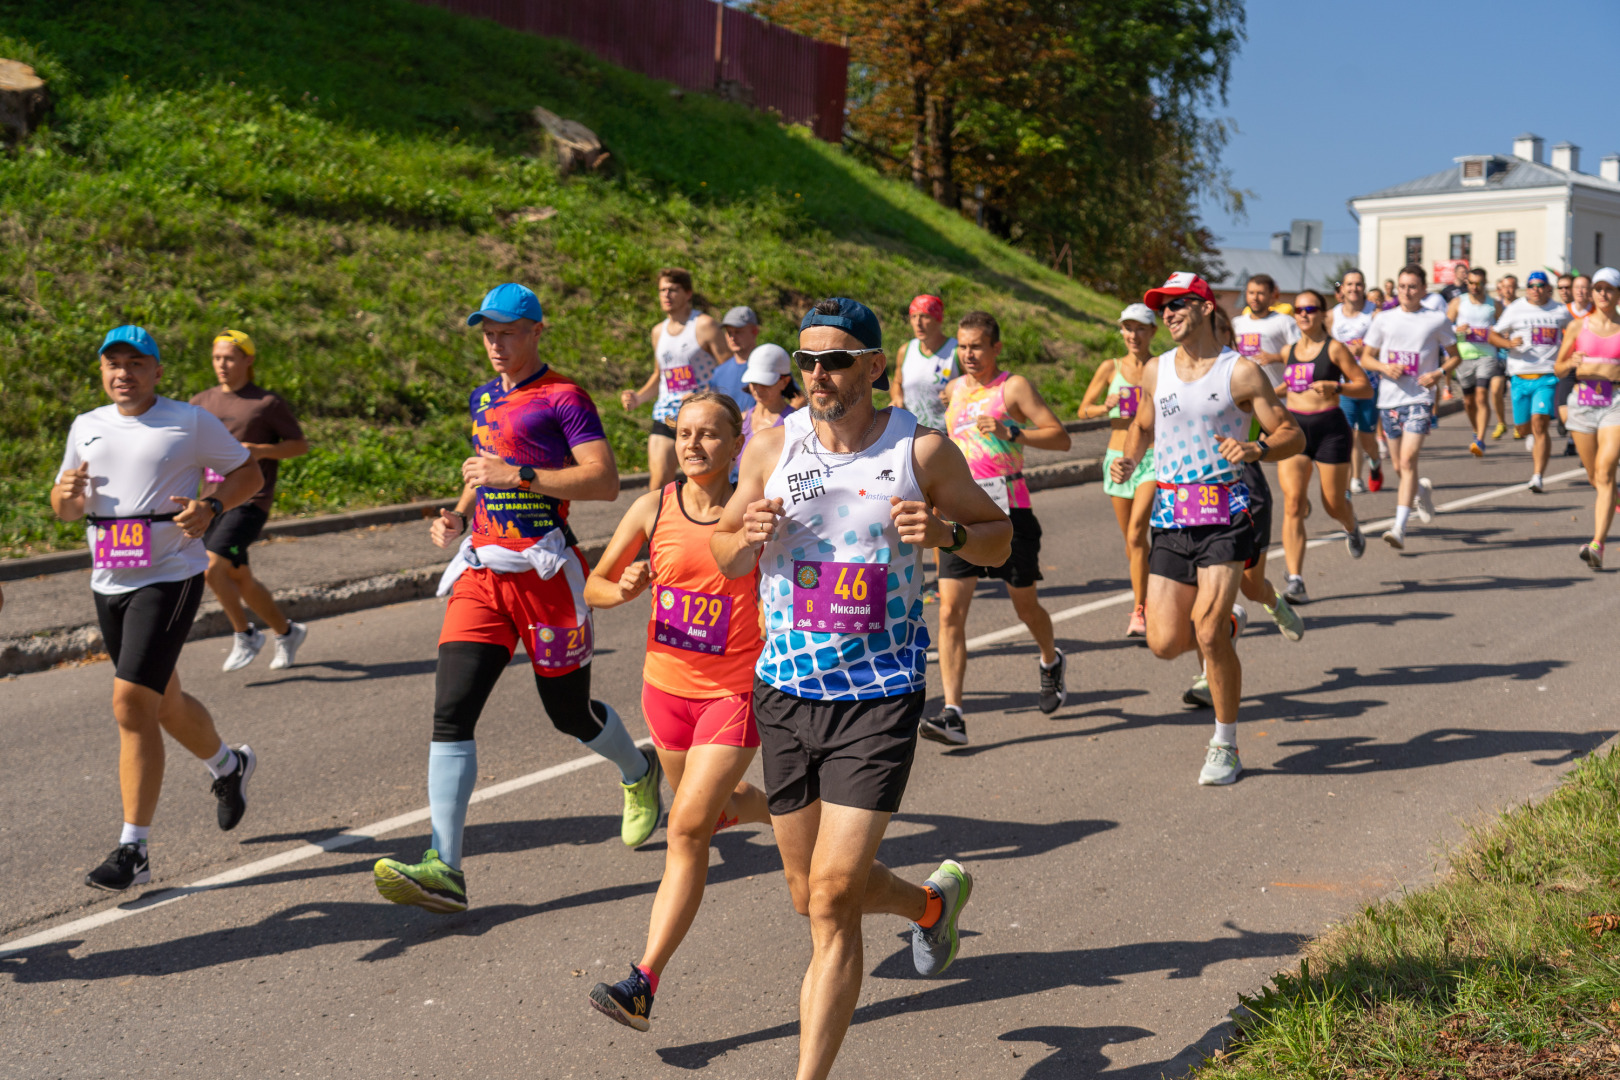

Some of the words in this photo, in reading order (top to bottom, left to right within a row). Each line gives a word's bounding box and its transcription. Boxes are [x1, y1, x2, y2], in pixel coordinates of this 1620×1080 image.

[787, 469, 822, 485] RUN
[791, 485, 826, 505] FUN
[1198, 485, 1219, 506] 35
[533, 520, 554, 528] 2024
[110, 523, 144, 547] 148
[834, 567, 868, 601] 46
[681, 594, 723, 627] 129
[830, 602, 871, 615] Микалай
[567, 624, 586, 649] 21
[687, 625, 707, 638] Анна
